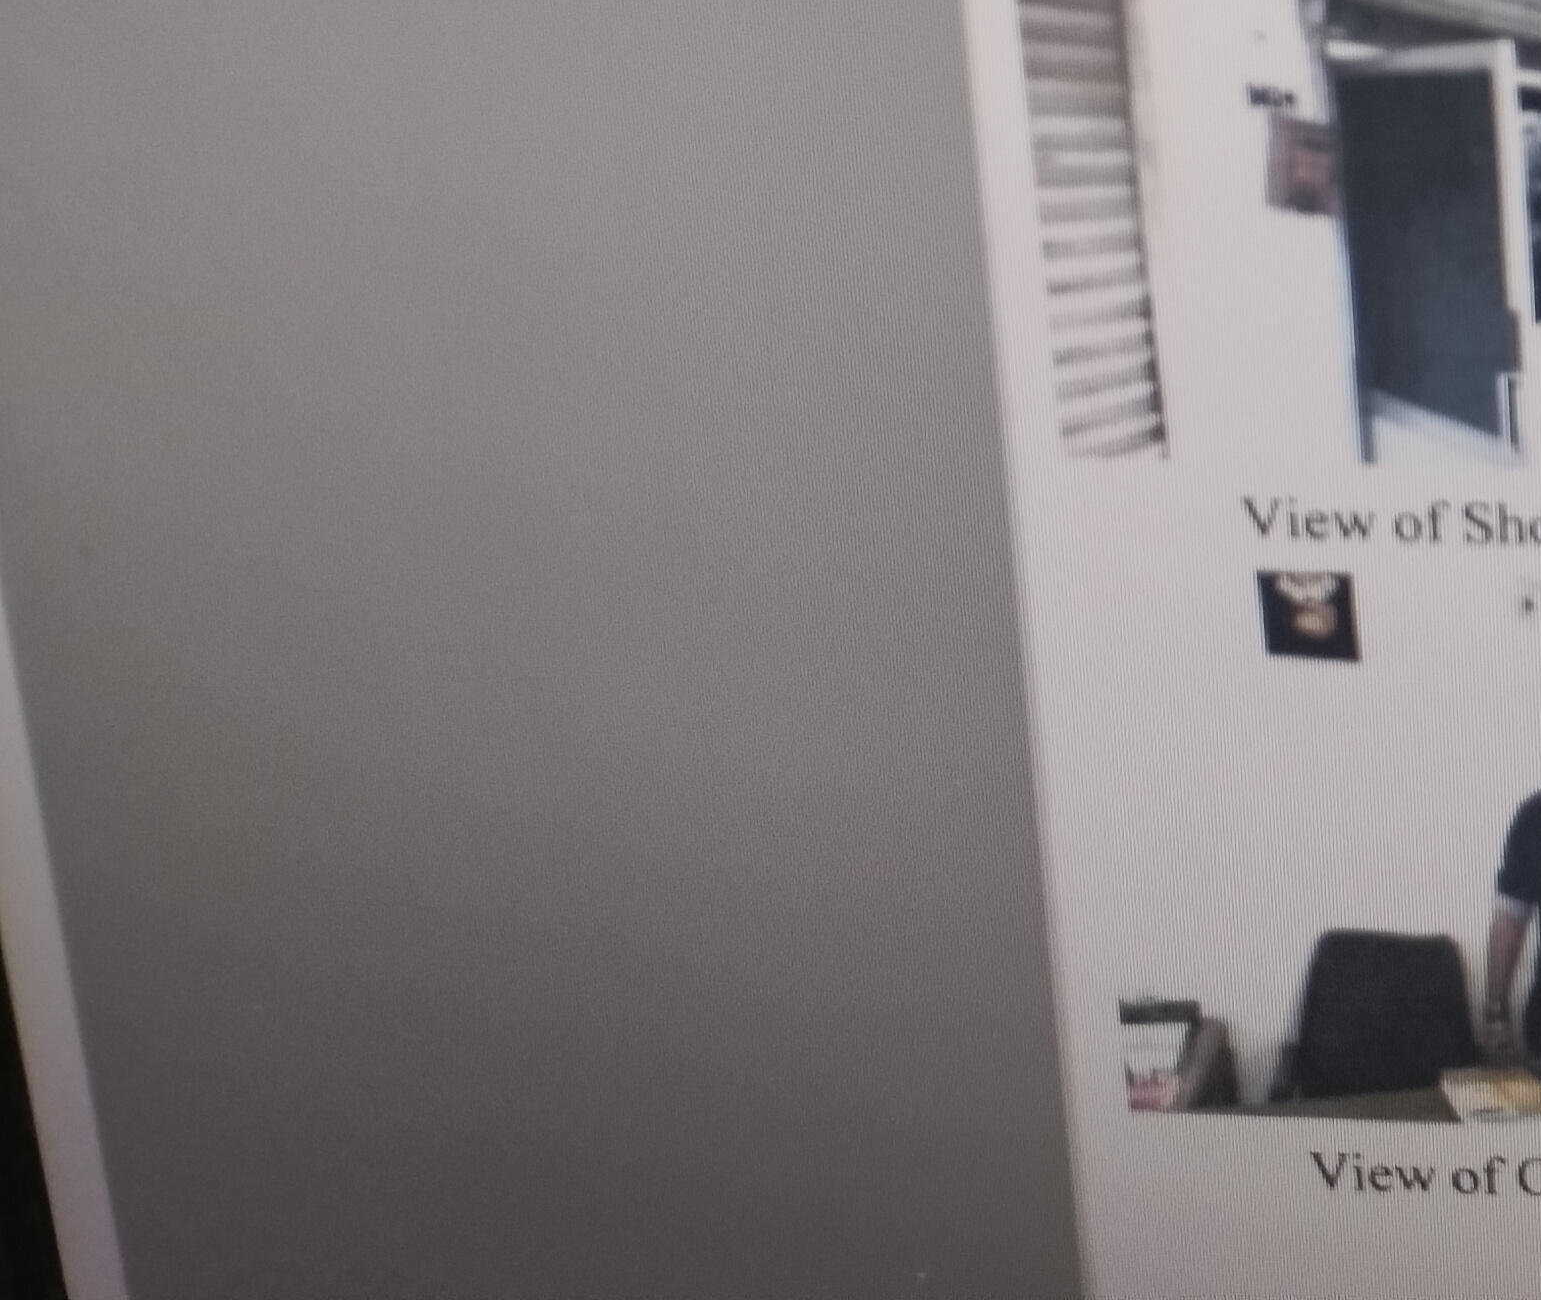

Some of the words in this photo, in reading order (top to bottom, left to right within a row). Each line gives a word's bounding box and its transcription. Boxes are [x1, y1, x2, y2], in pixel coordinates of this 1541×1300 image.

[1243, 497, 1373, 541] View
[1393, 501, 1449, 543] of
[1310, 1151, 1435, 1193] View
[1451, 1156, 1506, 1196] of
